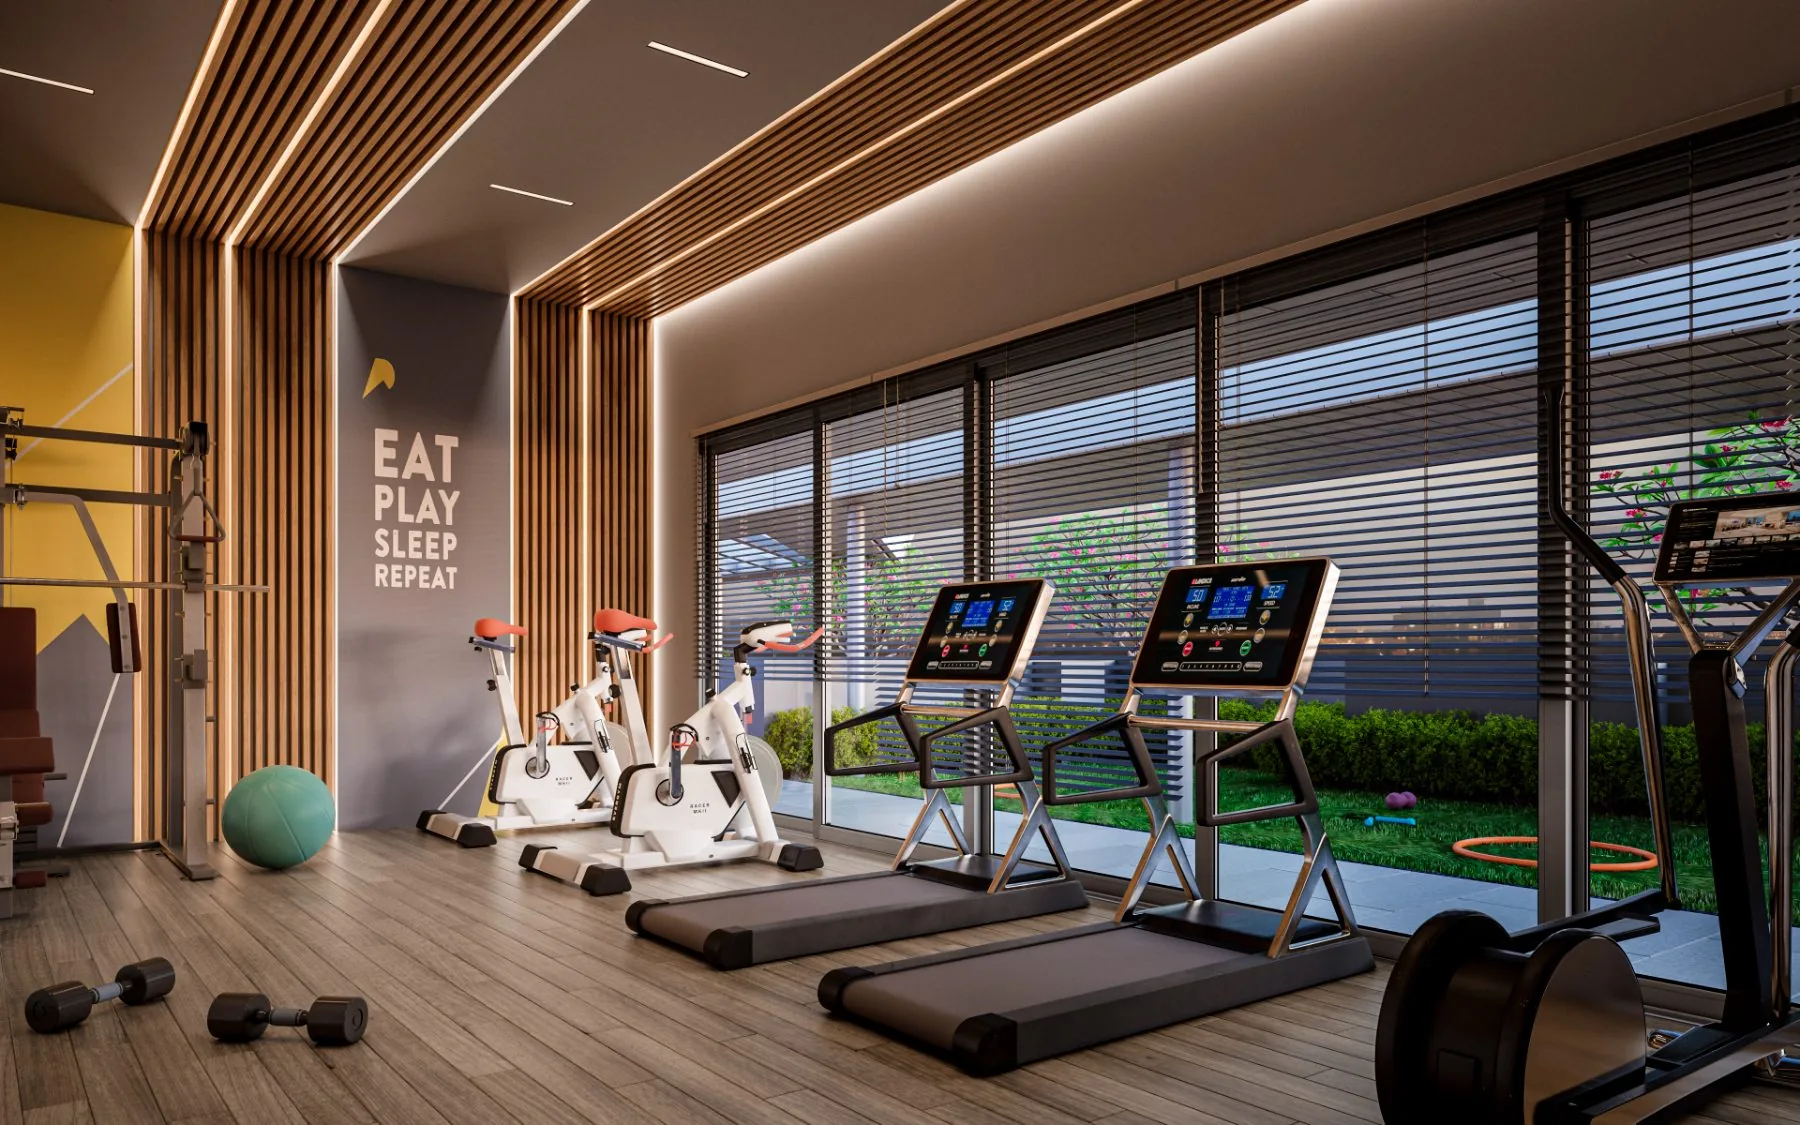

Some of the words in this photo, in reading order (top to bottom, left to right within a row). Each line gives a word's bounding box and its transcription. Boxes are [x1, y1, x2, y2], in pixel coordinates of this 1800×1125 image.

[374, 427, 460, 483] EAT
[374, 484, 461, 526] PLAY
[374, 527, 458, 561] SLEEP
[374, 563, 458, 590] REPEAT
